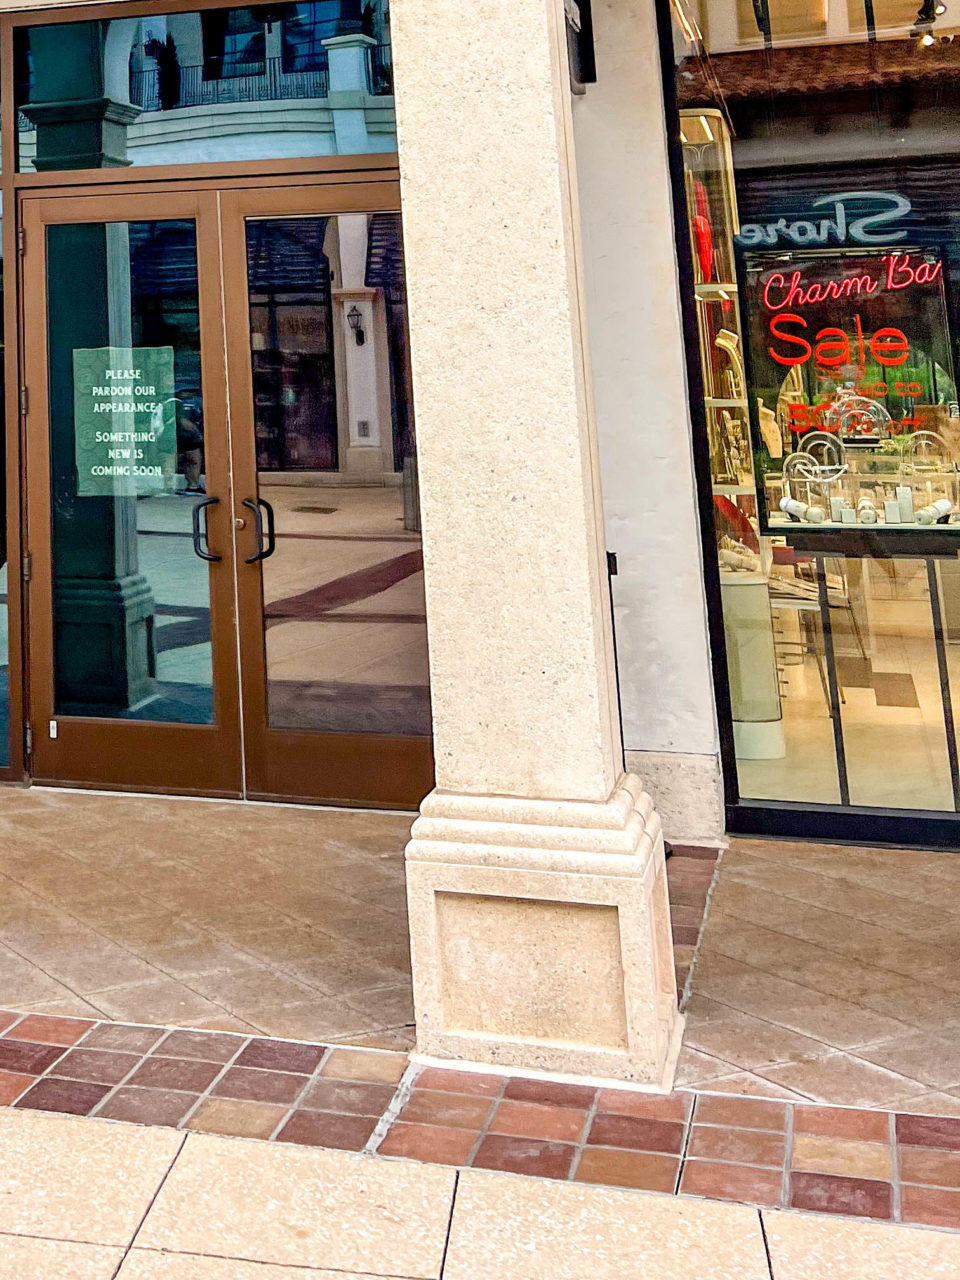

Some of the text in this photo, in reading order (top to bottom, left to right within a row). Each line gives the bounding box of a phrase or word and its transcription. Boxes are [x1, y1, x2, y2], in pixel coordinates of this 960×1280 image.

[762, 270, 878, 311] Charm
[768, 313, 909, 366] Sale
[105, 369, 142, 380] PLEASE
[92, 385, 156, 396] PARDON OUR
[893, 381, 924, 397] to
[787, 402, 874, 434] 50%
[95, 431, 156, 442] SOMETHING
[108, 448, 144, 459] NEW IS
[91, 465, 162, 476] COMING SOON
